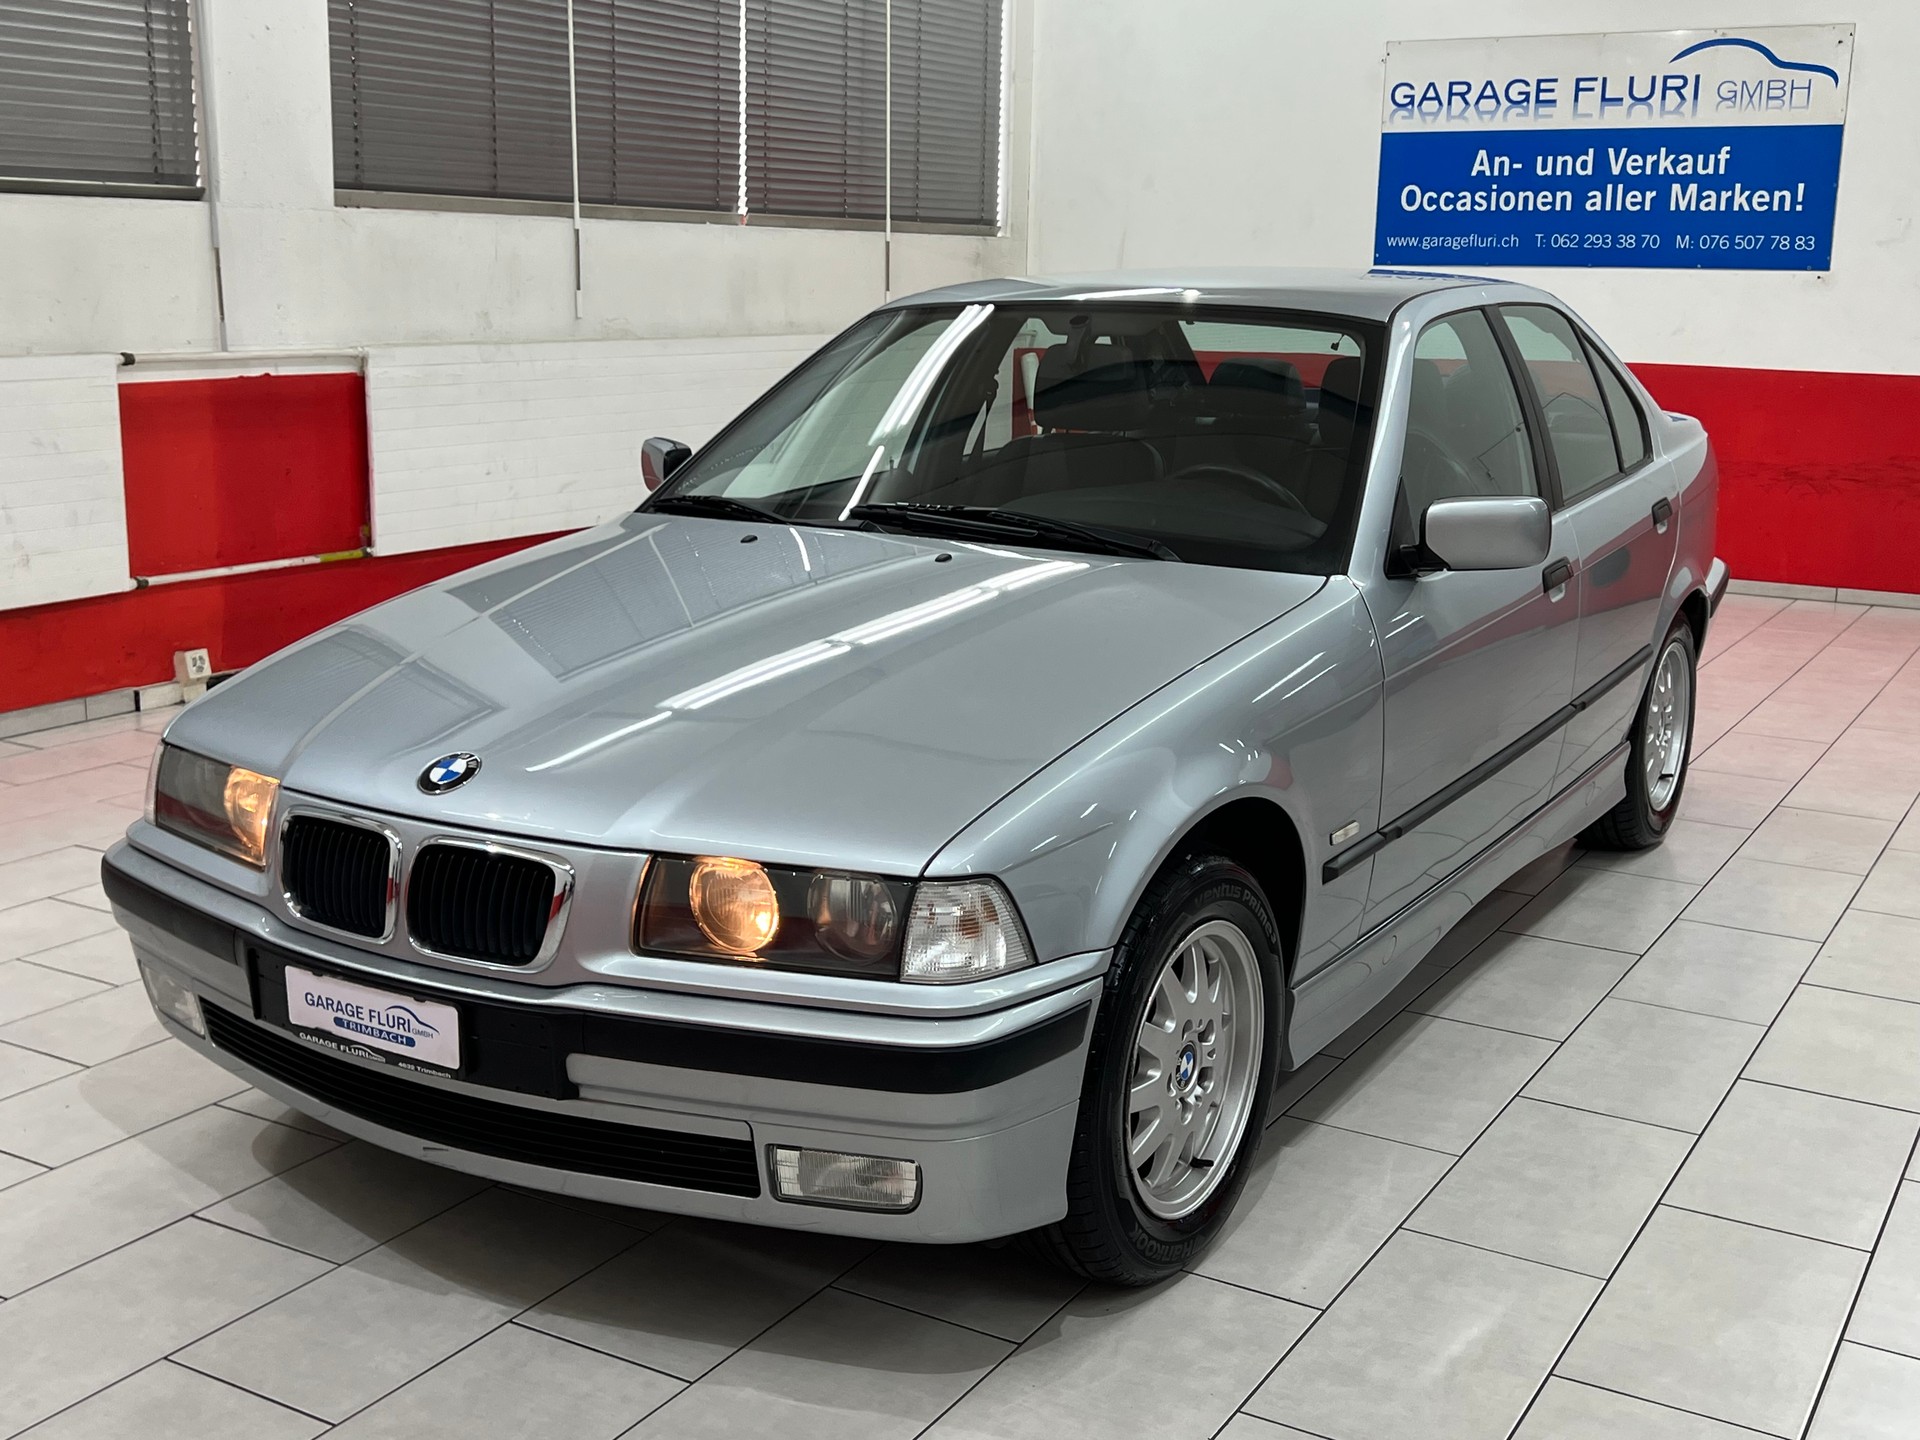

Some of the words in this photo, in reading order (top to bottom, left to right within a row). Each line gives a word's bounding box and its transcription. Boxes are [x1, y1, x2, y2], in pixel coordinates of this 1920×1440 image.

[1390, 78, 1559, 109] GARAGE
[1574, 73, 1701, 104] FLURI
[1716, 78, 1812, 102] GMBH
[1470, 149, 1523, 177] An-
[1536, 147, 1594, 176] und
[1607, 145, 1731, 176] Verkauf
[1400, 184, 1573, 212] Occasionen
[1585, 183, 1657, 212] aller
[1669, 182, 1805, 212] Marken!
[1387, 233, 1519, 250] www.garagefluri.ch
[1535, 233, 1547, 248] T:
[1551, 234, 1579, 248] 062
[1583, 234, 1612, 248] 293
[1616, 234, 1636, 249] 38
[1641, 234, 1660, 249] 70
[1676, 234, 1694, 249] M:
[1699, 234, 1730, 250] 076
[1734, 235, 1765, 250] 507
[1770, 235, 1790, 250] 78
[1794, 235, 1815, 251] 83
[304, 992, 365, 1021] GARAGE
[368, 1008, 412, 1034] FLURI
[299, 1031, 338, 1051] GARAGE
[340, 1044, 369, 1059] FLURI
[342, 1019, 408, 1046] TRIMBACH
[416, 1064, 452, 1079] Trimbach
